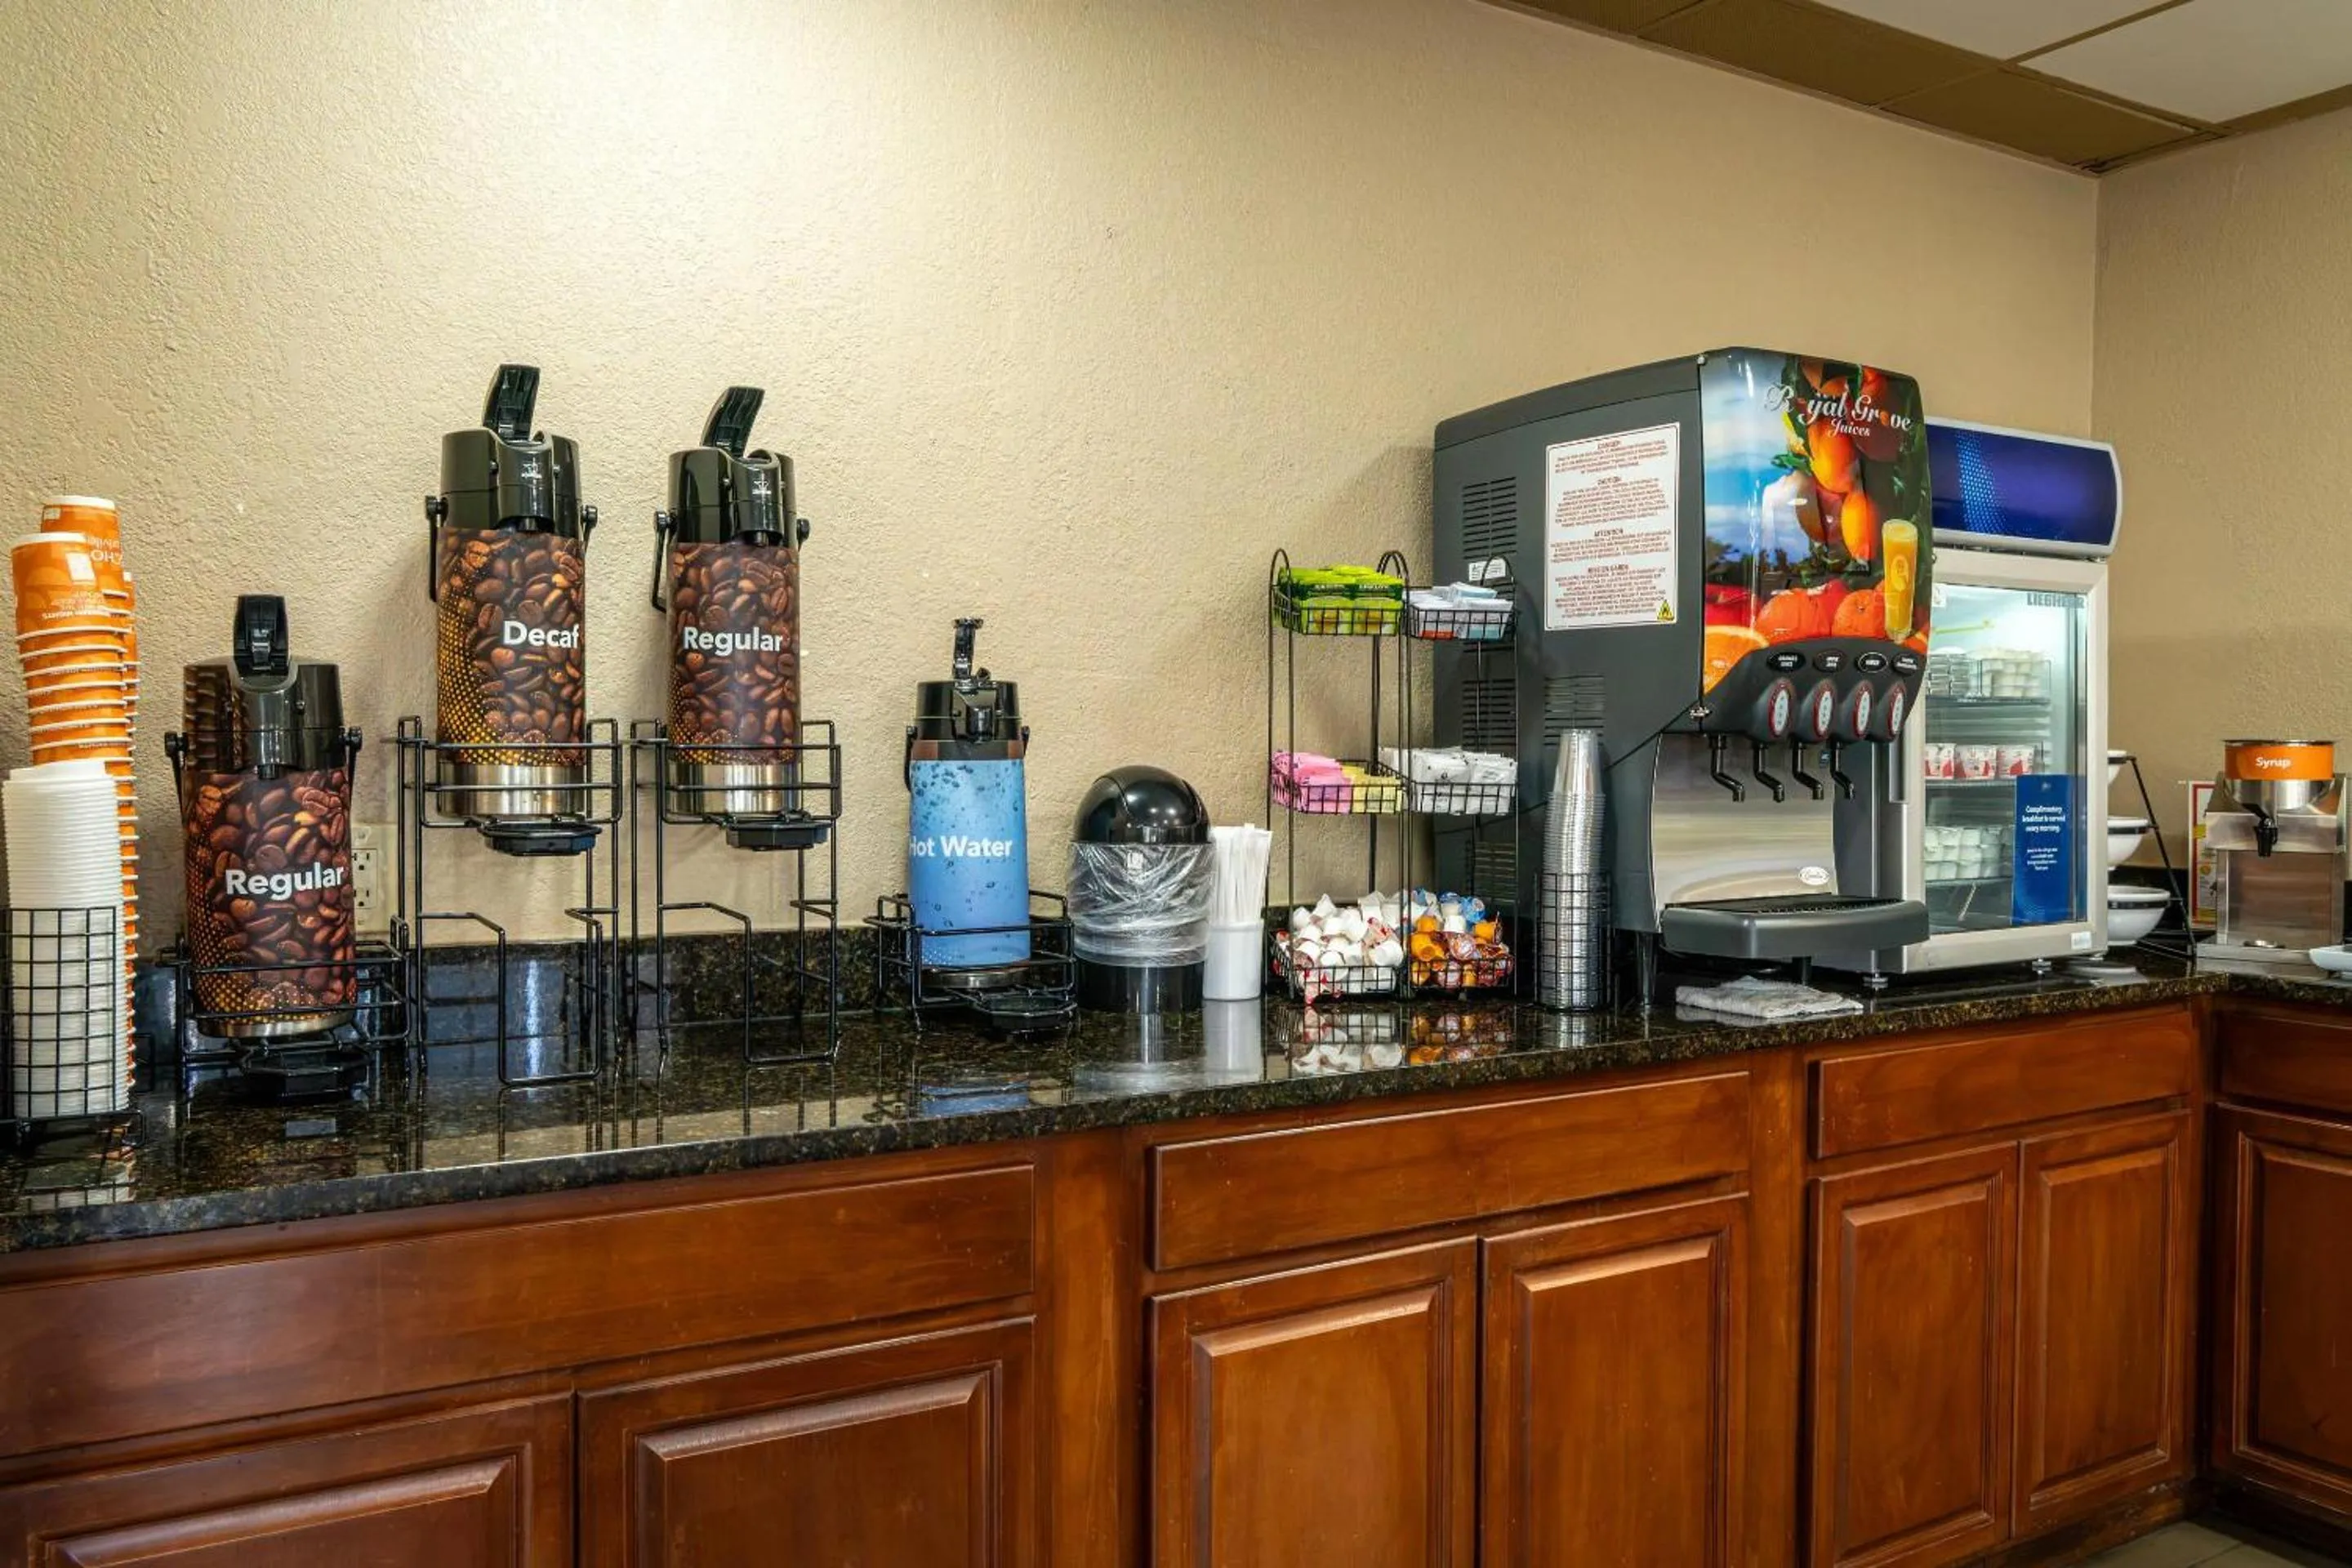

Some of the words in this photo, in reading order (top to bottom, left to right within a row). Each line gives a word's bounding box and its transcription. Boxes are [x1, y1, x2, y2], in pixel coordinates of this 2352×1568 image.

[1765, 384, 1848, 425] Royal
[1851, 394, 1912, 431] Grove
[1828, 418, 1870, 437] Juices
[503, 620, 581, 649] Decaf
[683, 626, 784, 657] Regular
[2255, 756, 2292, 769] Syrup
[940, 835, 1013, 858] Water
[225, 861, 344, 901] Regular
